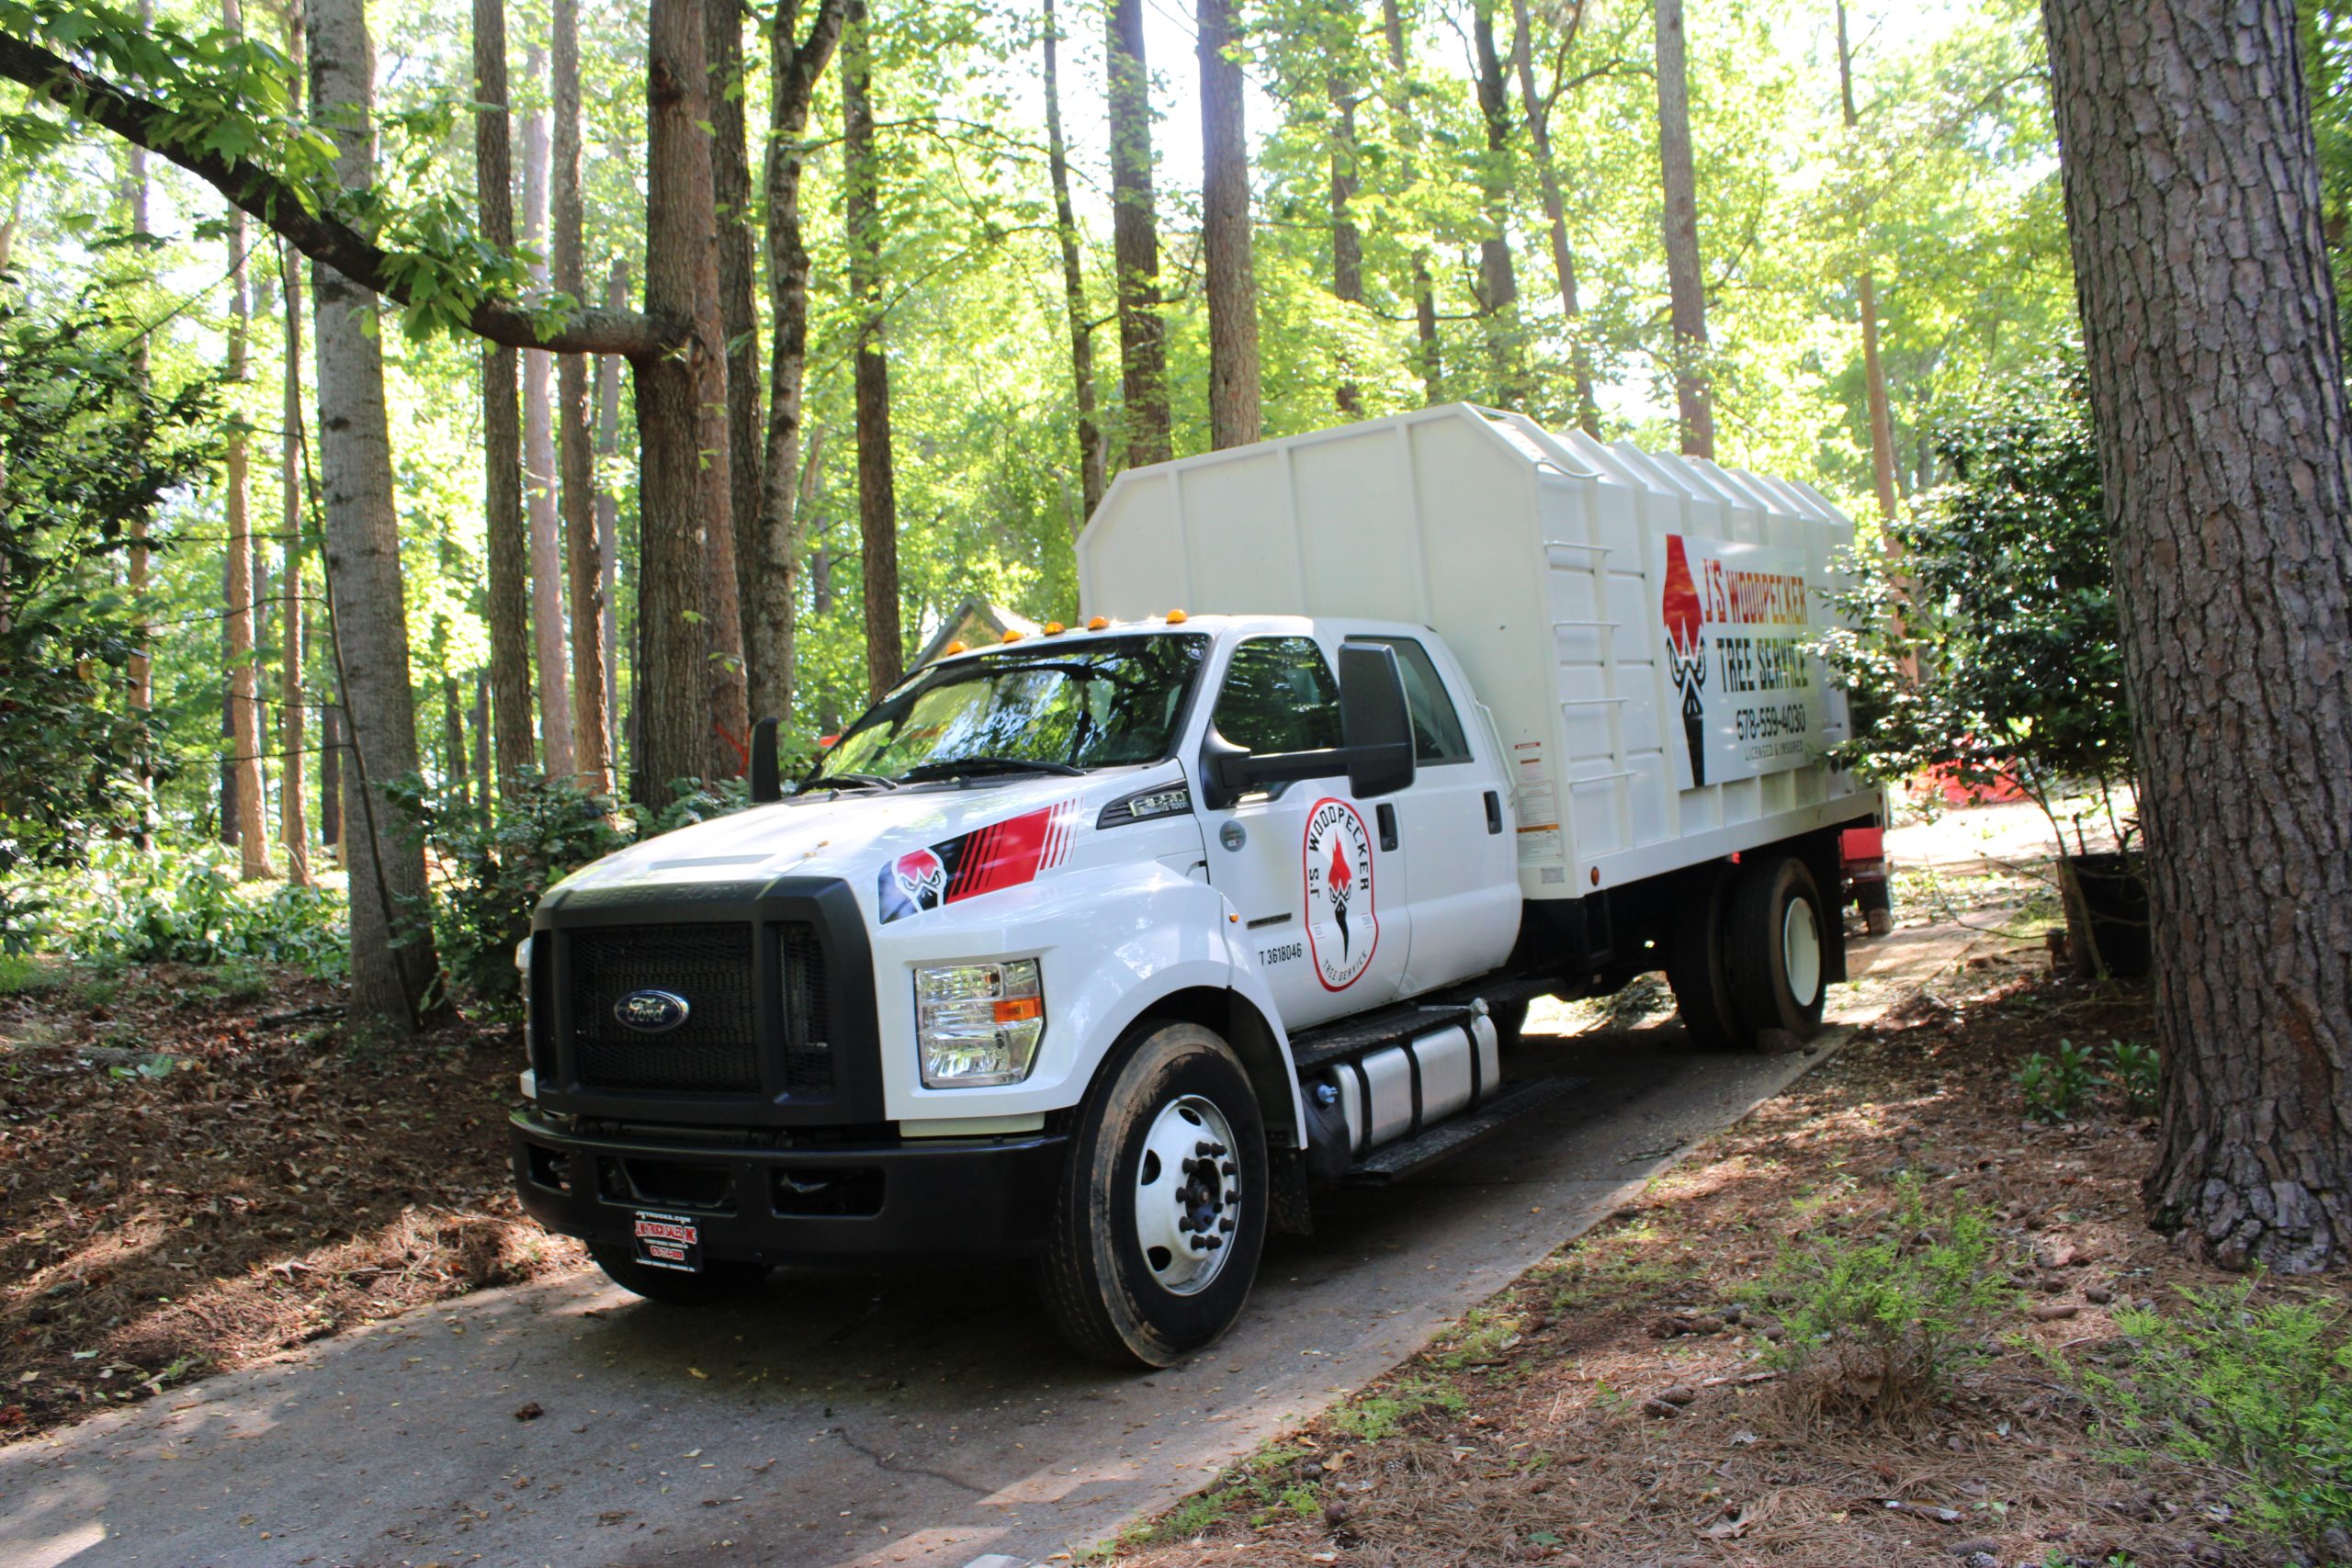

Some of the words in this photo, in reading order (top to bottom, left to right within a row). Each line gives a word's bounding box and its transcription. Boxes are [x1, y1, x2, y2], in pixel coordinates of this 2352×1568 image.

[1703, 558, 1726, 623] J'S
[1726, 570, 1808, 625] WOODPECKER
[1716, 637, 1755, 693] TREE
[1757, 637, 1808, 690] SERVICE
[1736, 704, 1806, 740] 678-559-4030
[1308, 806, 1369, 891] WOODPECKER
[1267, 942, 1302, 965] 3618046
[1323, 959, 1338, 981] TREE
[1338, 948, 1368, 981] SERVICE
[627, 997, 666, 1021] Ford
